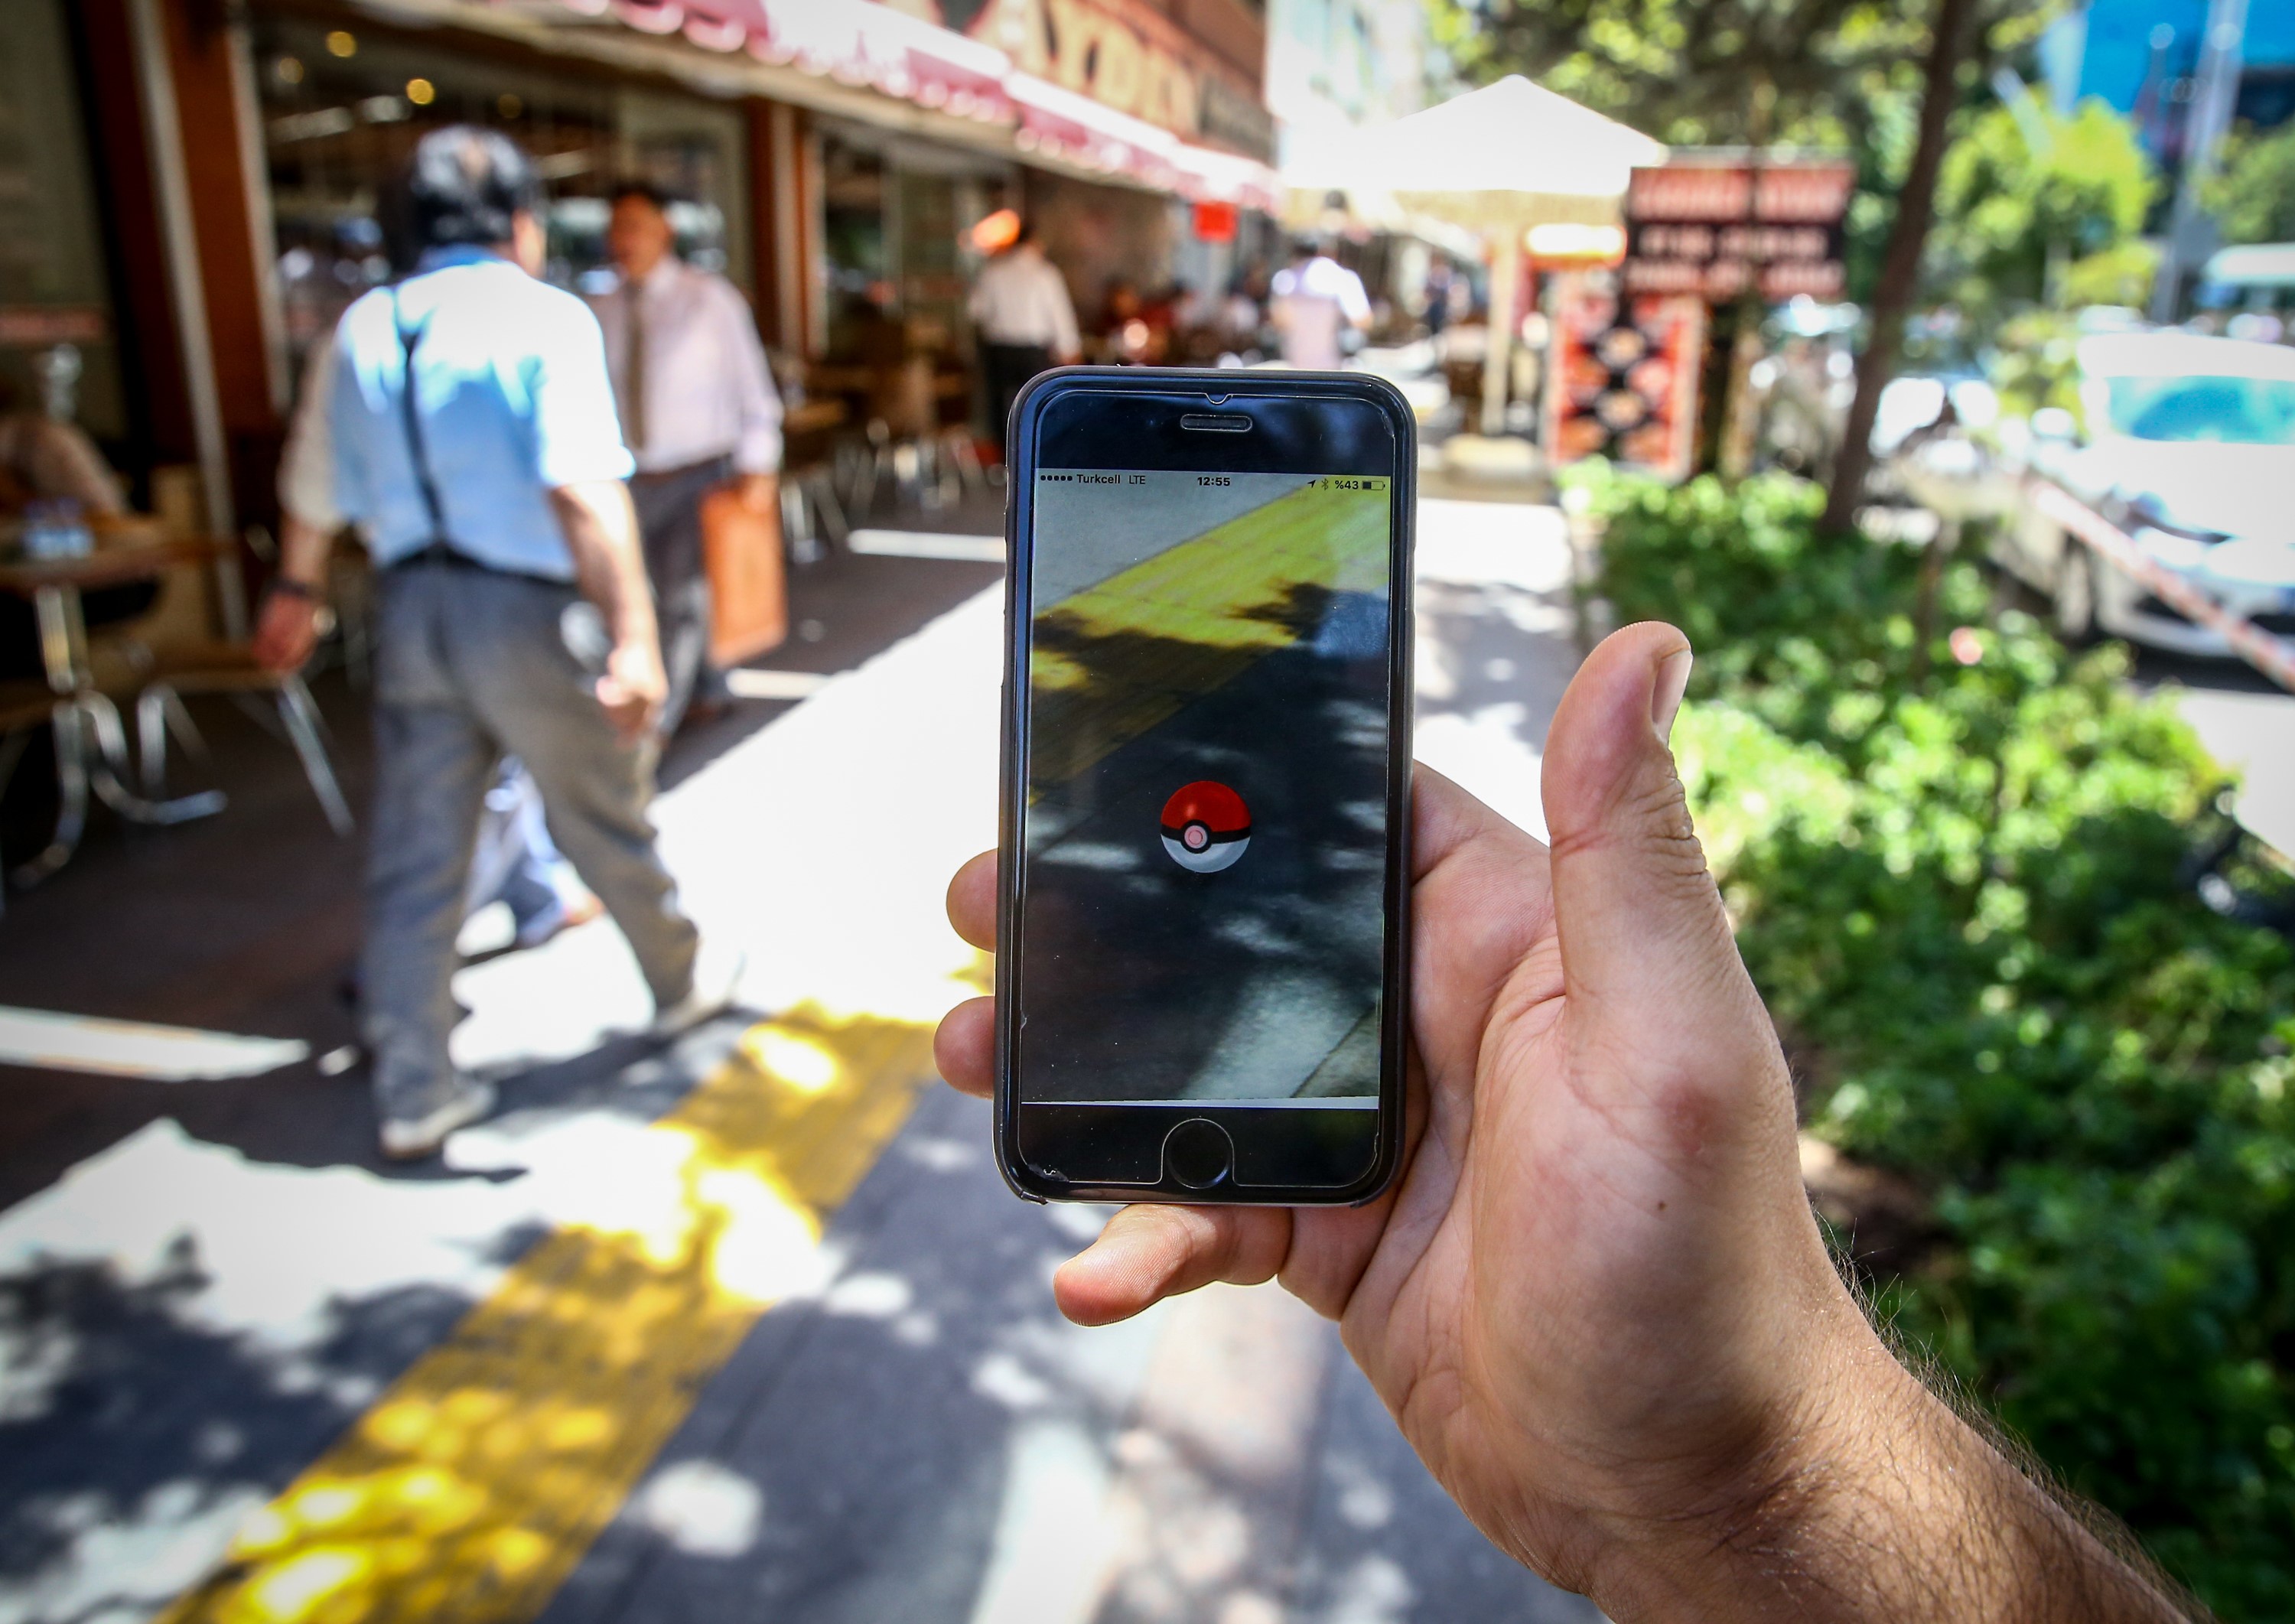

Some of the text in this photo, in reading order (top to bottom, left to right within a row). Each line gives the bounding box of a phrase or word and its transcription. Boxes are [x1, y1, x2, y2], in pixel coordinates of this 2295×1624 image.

[1076, 474, 1146, 485] Turkcell LTE
[1197, 477, 1231, 487] 12:55
[1334, 480, 1359, 490] %43
